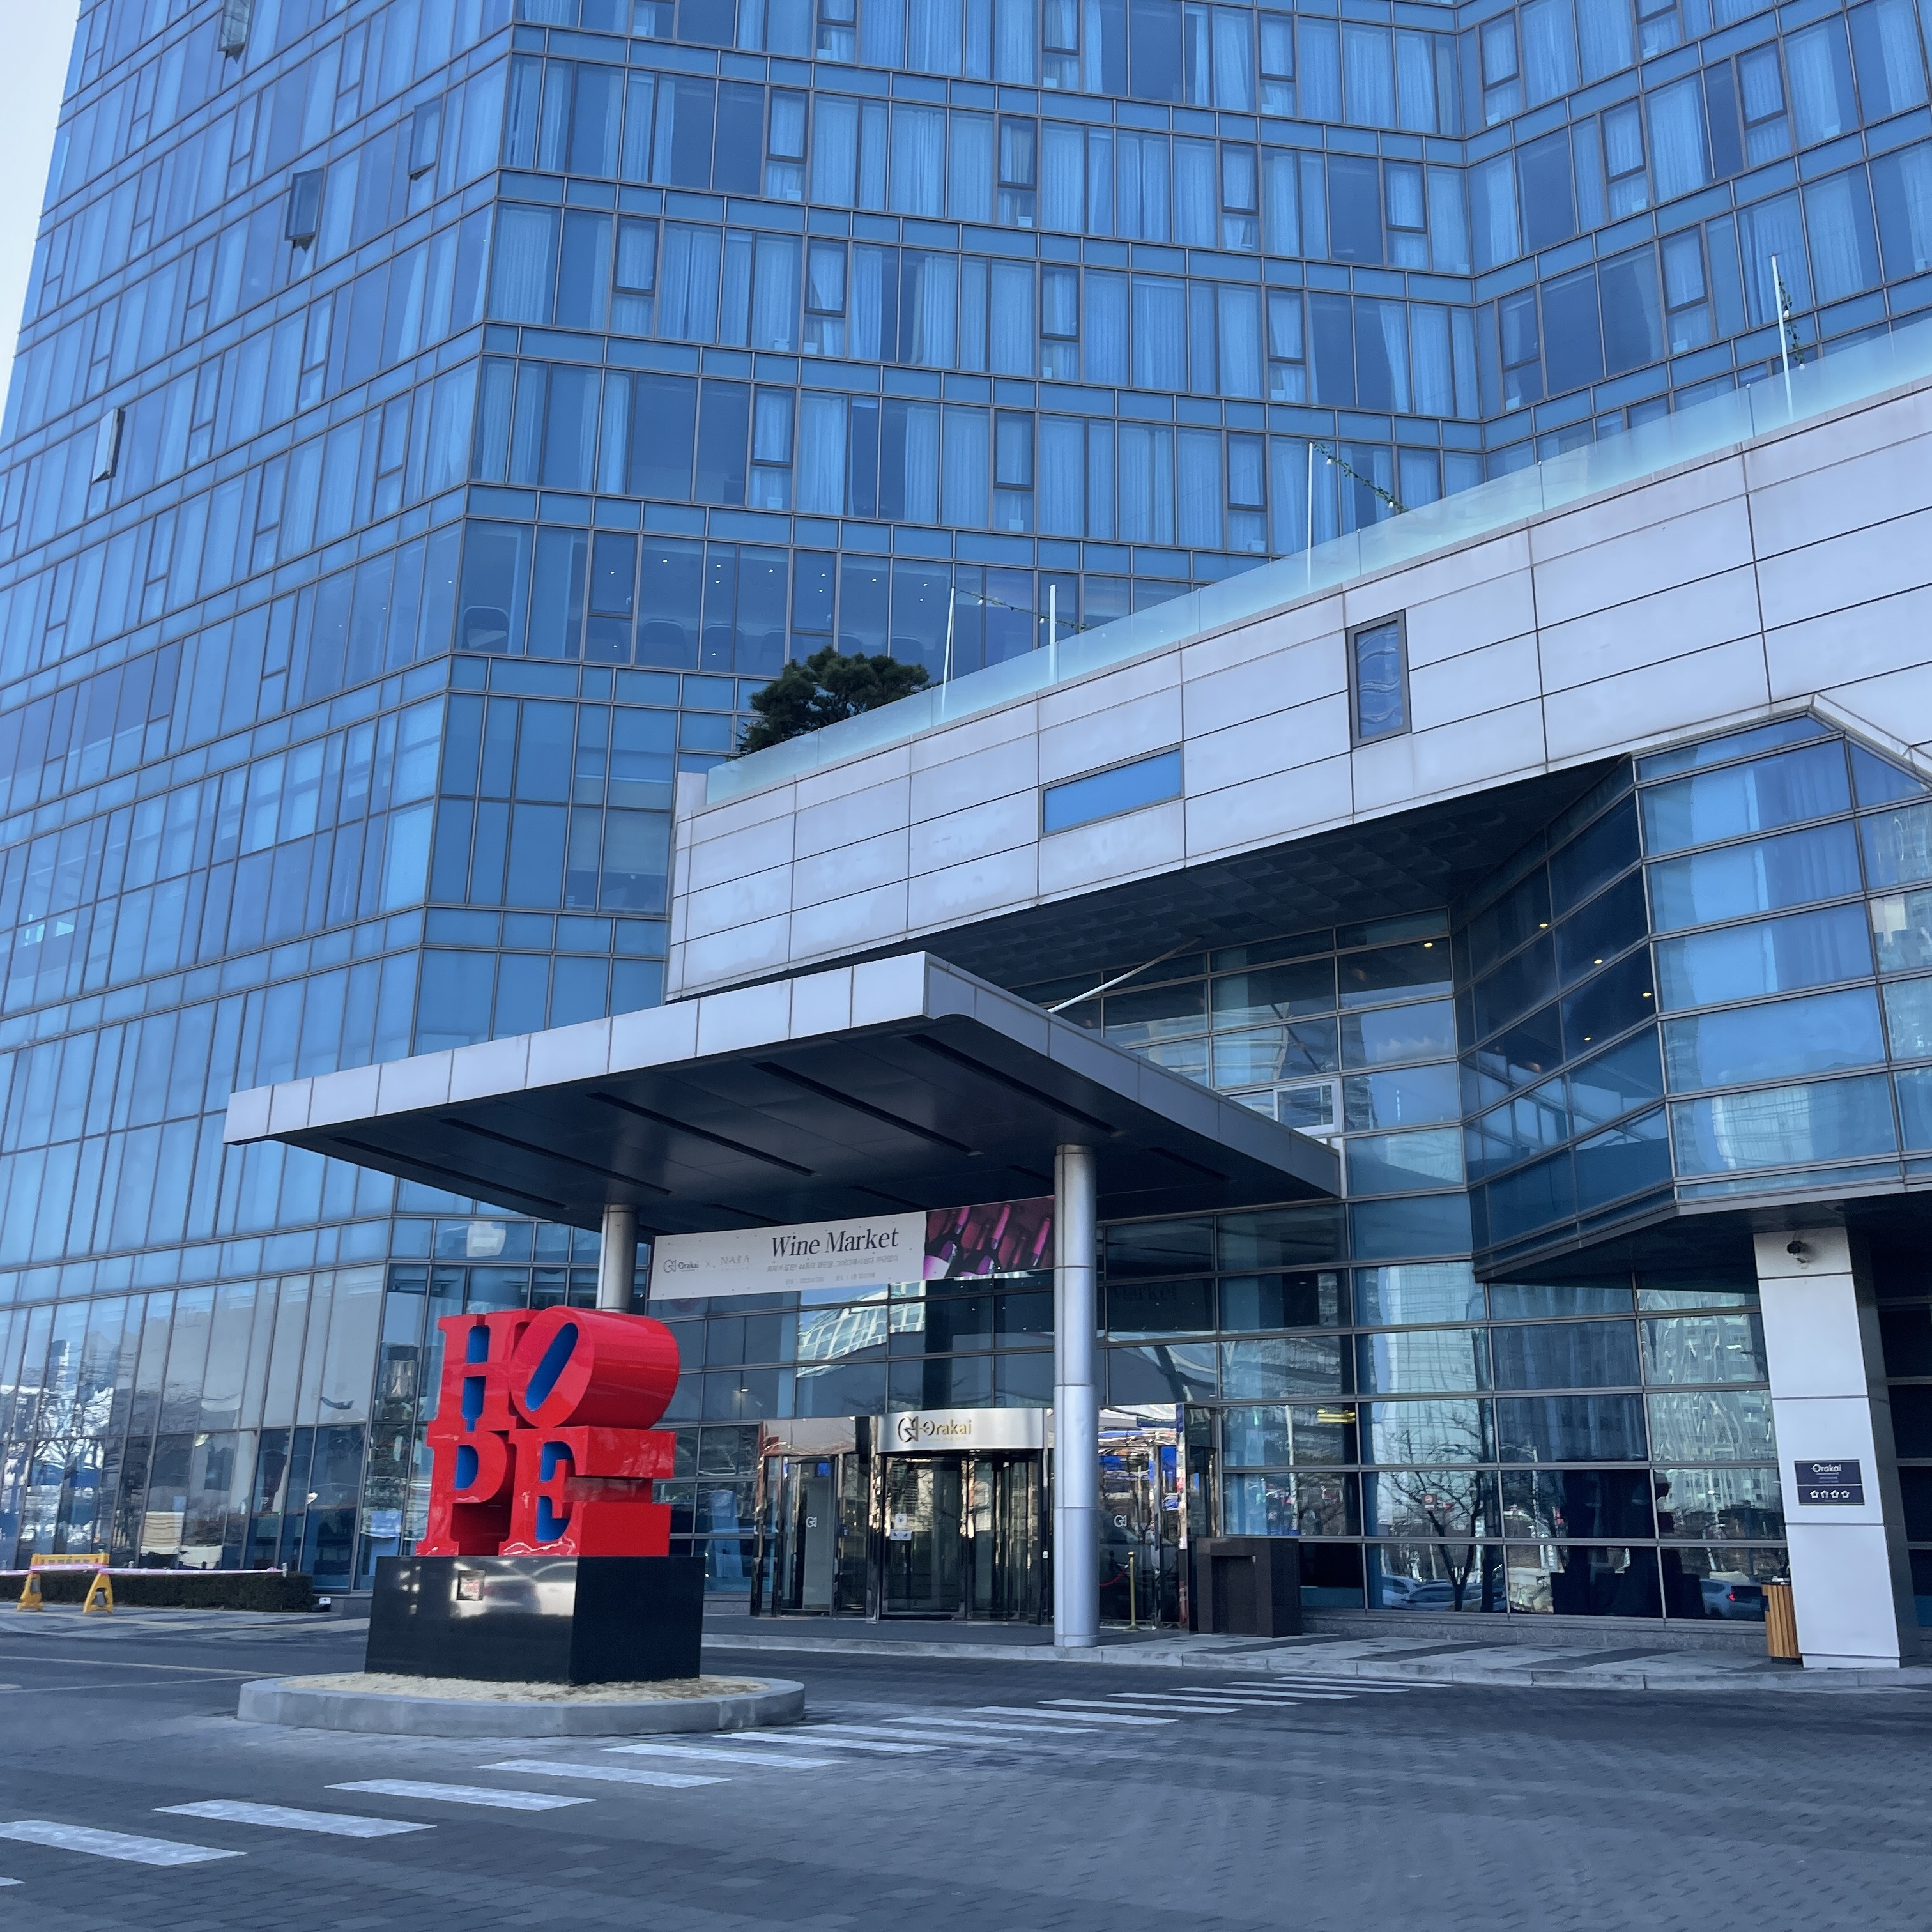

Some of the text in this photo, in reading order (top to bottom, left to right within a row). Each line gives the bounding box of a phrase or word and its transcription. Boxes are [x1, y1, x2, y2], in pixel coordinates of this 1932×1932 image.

[772, 1227, 900, 1257] Wine Market
[678, 1261, 700, 1269] Orakai
[921, 1419, 972, 1436] Orakai
[1811, 1464, 1841, 1472] Orakai
